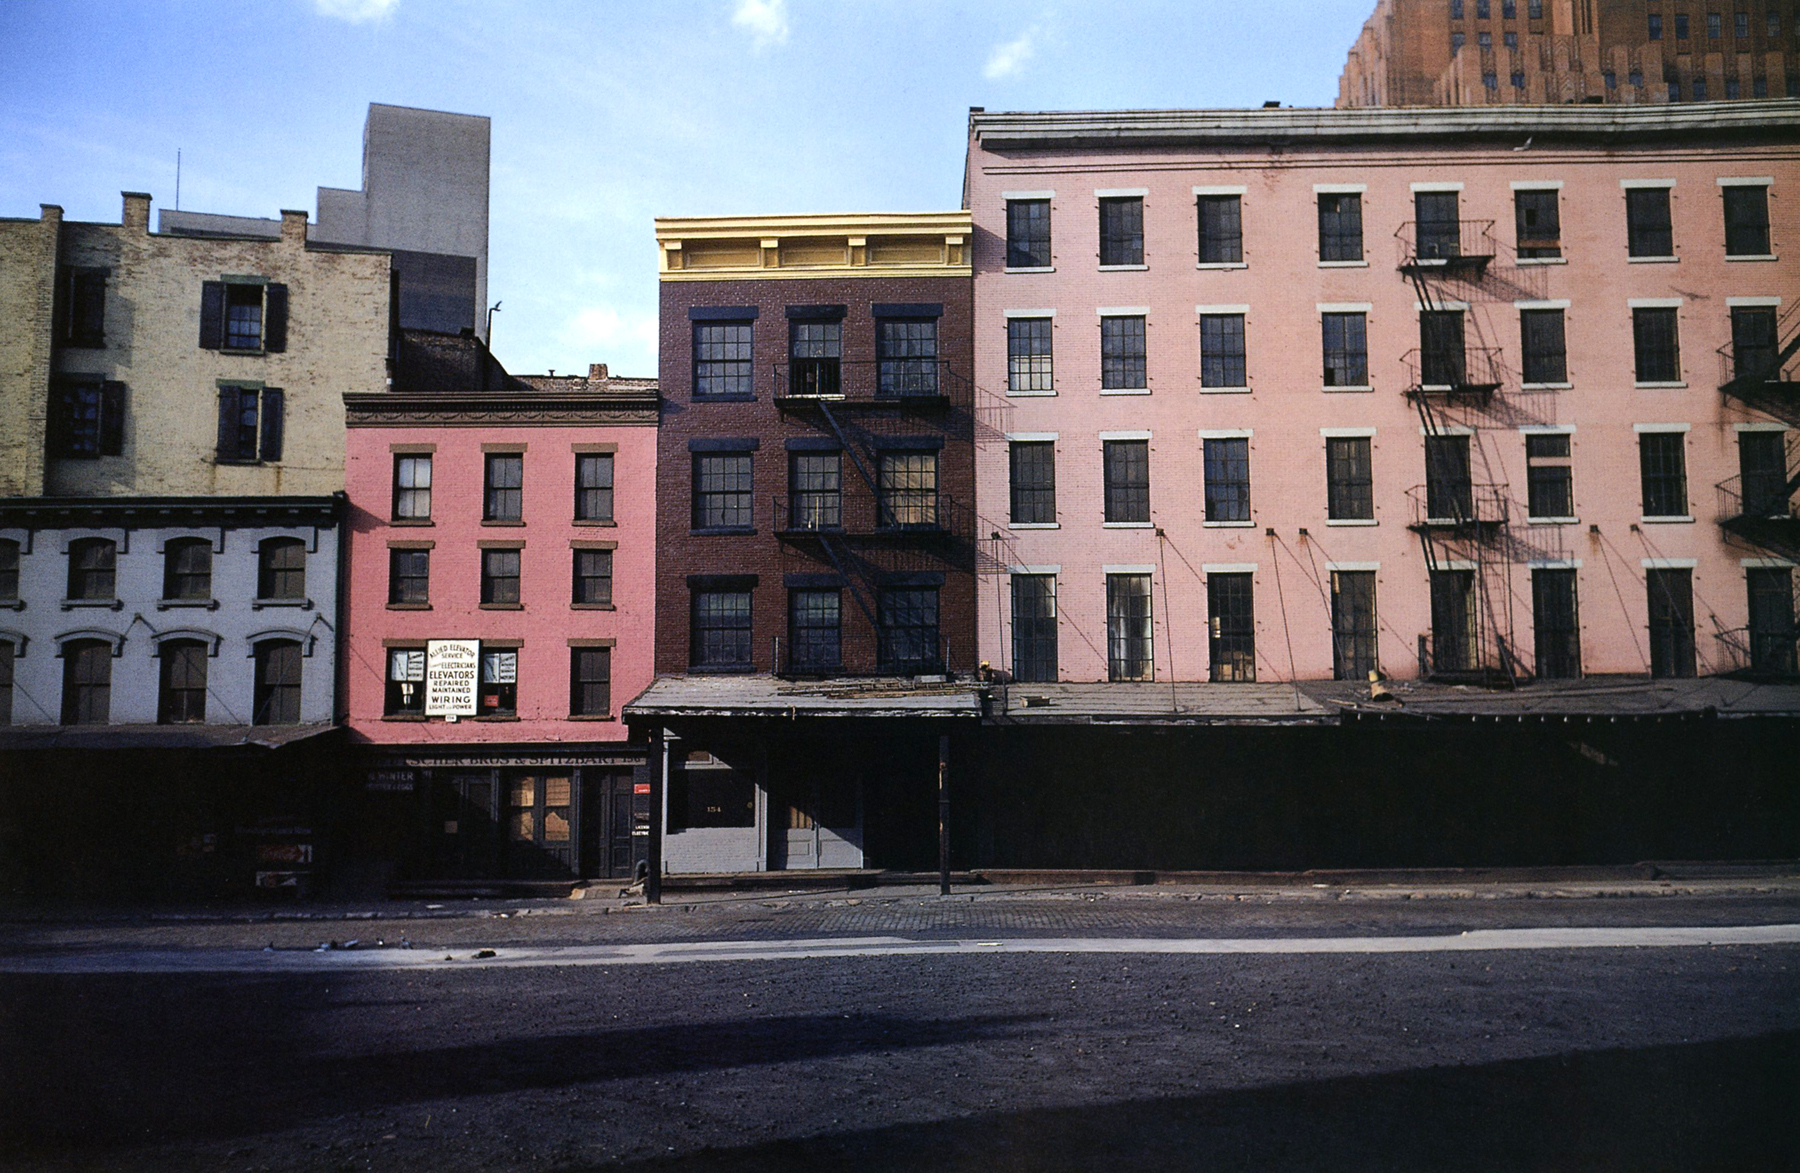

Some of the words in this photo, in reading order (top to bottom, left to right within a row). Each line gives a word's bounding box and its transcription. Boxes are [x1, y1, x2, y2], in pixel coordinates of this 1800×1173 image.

[429, 645, 448, 659] ALLIED
[449, 644, 476, 659] ELEVATOR
[429, 670, 475, 680] ELEVATORS
[431, 696, 471, 704] WIRING
